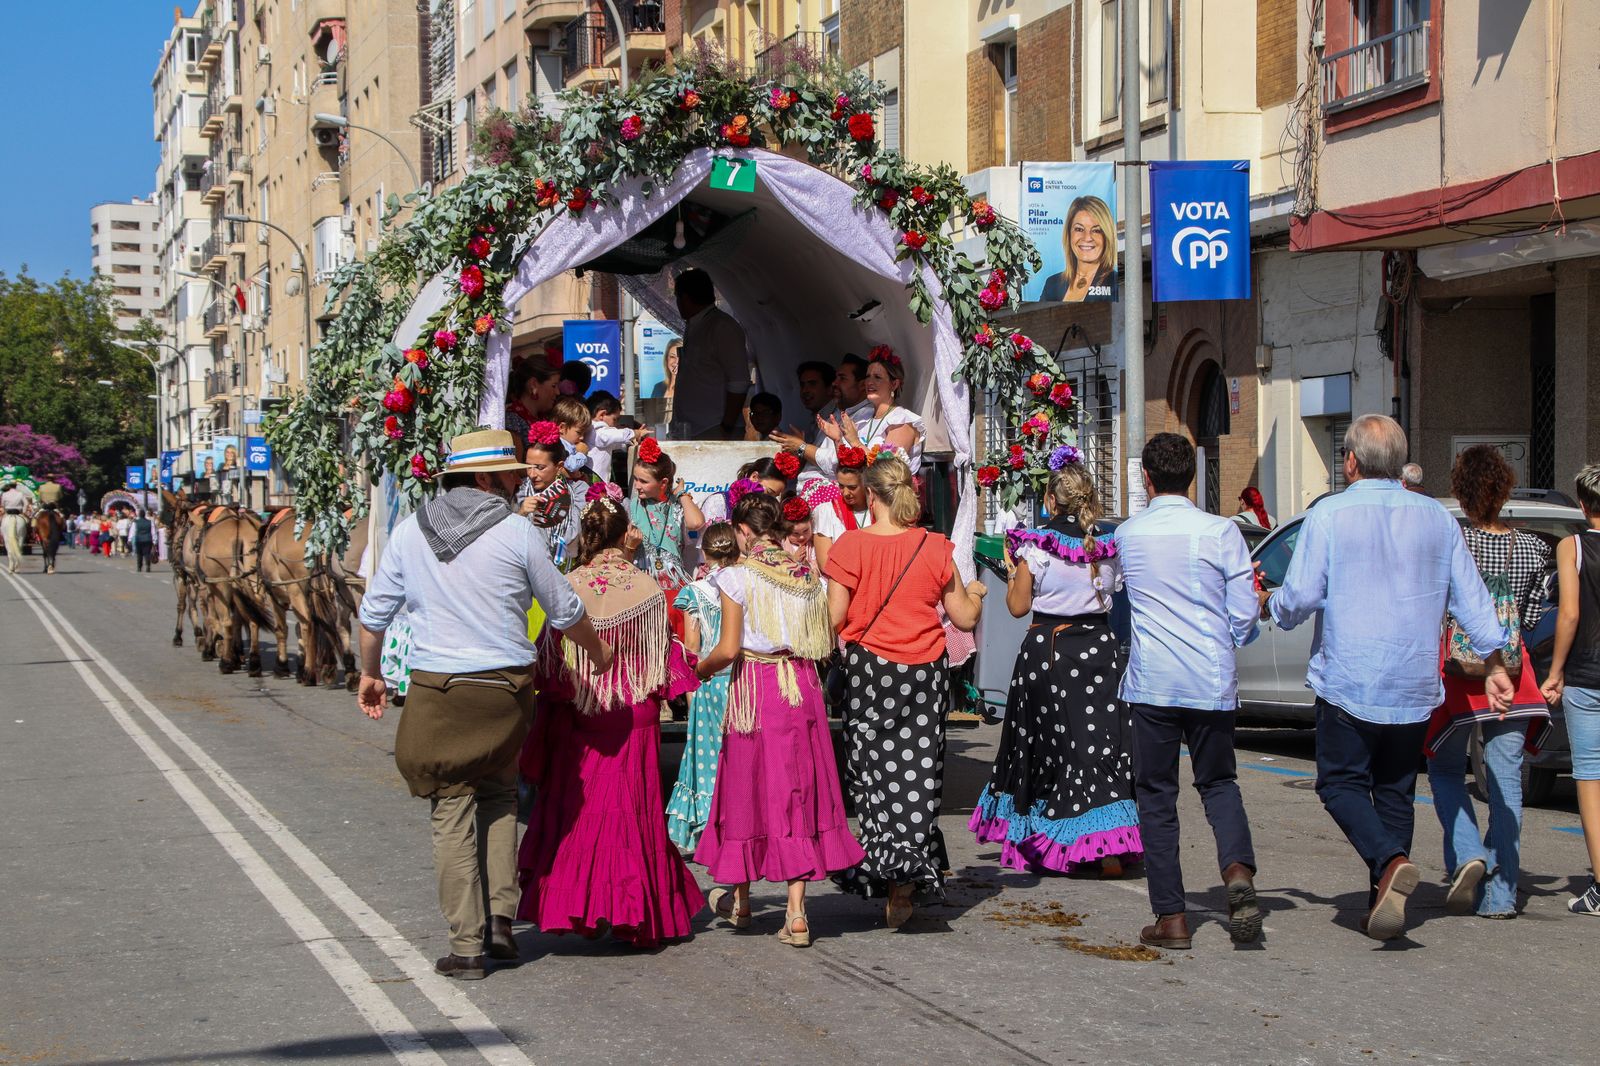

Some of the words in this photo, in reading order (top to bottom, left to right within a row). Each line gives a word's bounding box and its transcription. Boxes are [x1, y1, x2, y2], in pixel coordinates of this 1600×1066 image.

[726, 161, 742, 187] 7
[1028, 209, 1048, 217] Pilar
[1170, 201, 1230, 221] VOTA
[1028, 217, 1064, 225] Miranda
[1088, 285, 1112, 296] 28M
[575, 342, 610, 354] VOTA
